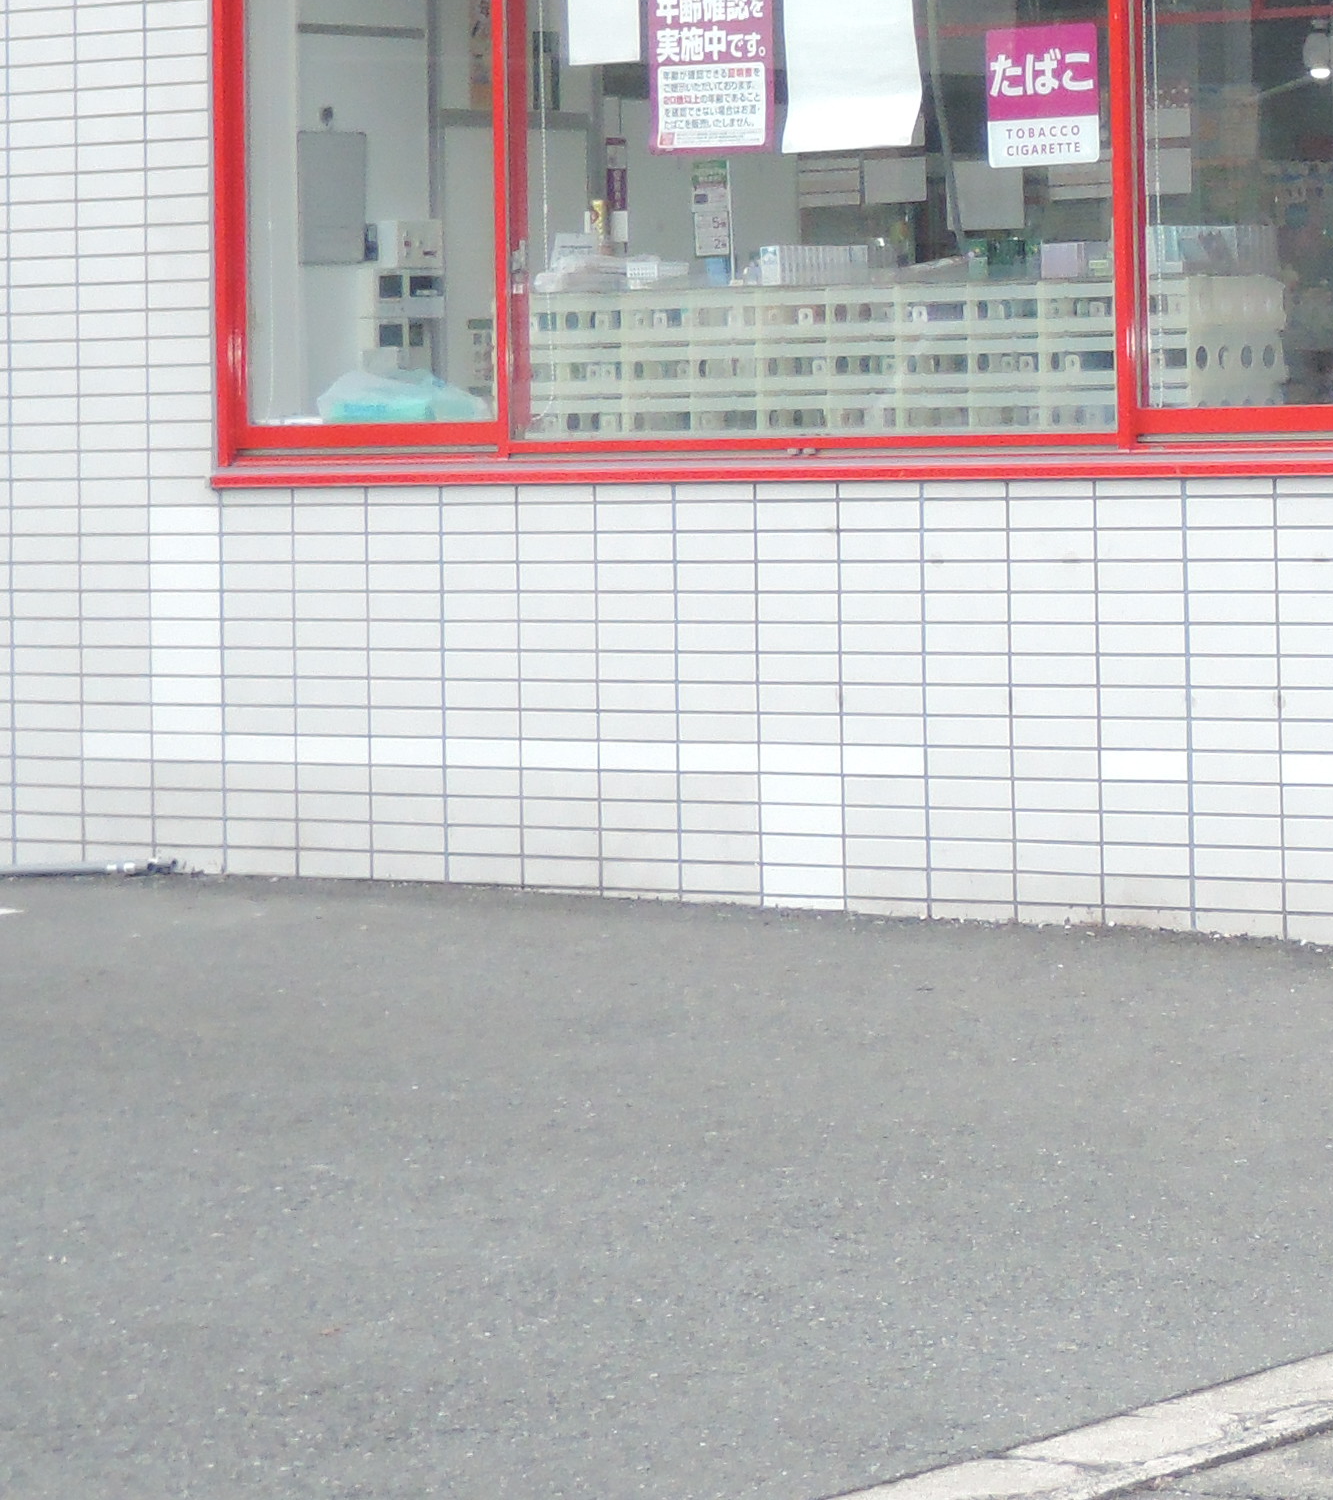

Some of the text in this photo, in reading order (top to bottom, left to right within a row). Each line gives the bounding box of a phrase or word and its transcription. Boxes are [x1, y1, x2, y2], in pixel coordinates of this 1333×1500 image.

[655, 25, 766, 63] 実施中です。
[989, 47, 1094, 97] たばこ
[1006, 124, 1081, 140] TOBACCO
[1006, 141, 1081, 157] CIGARETTE
